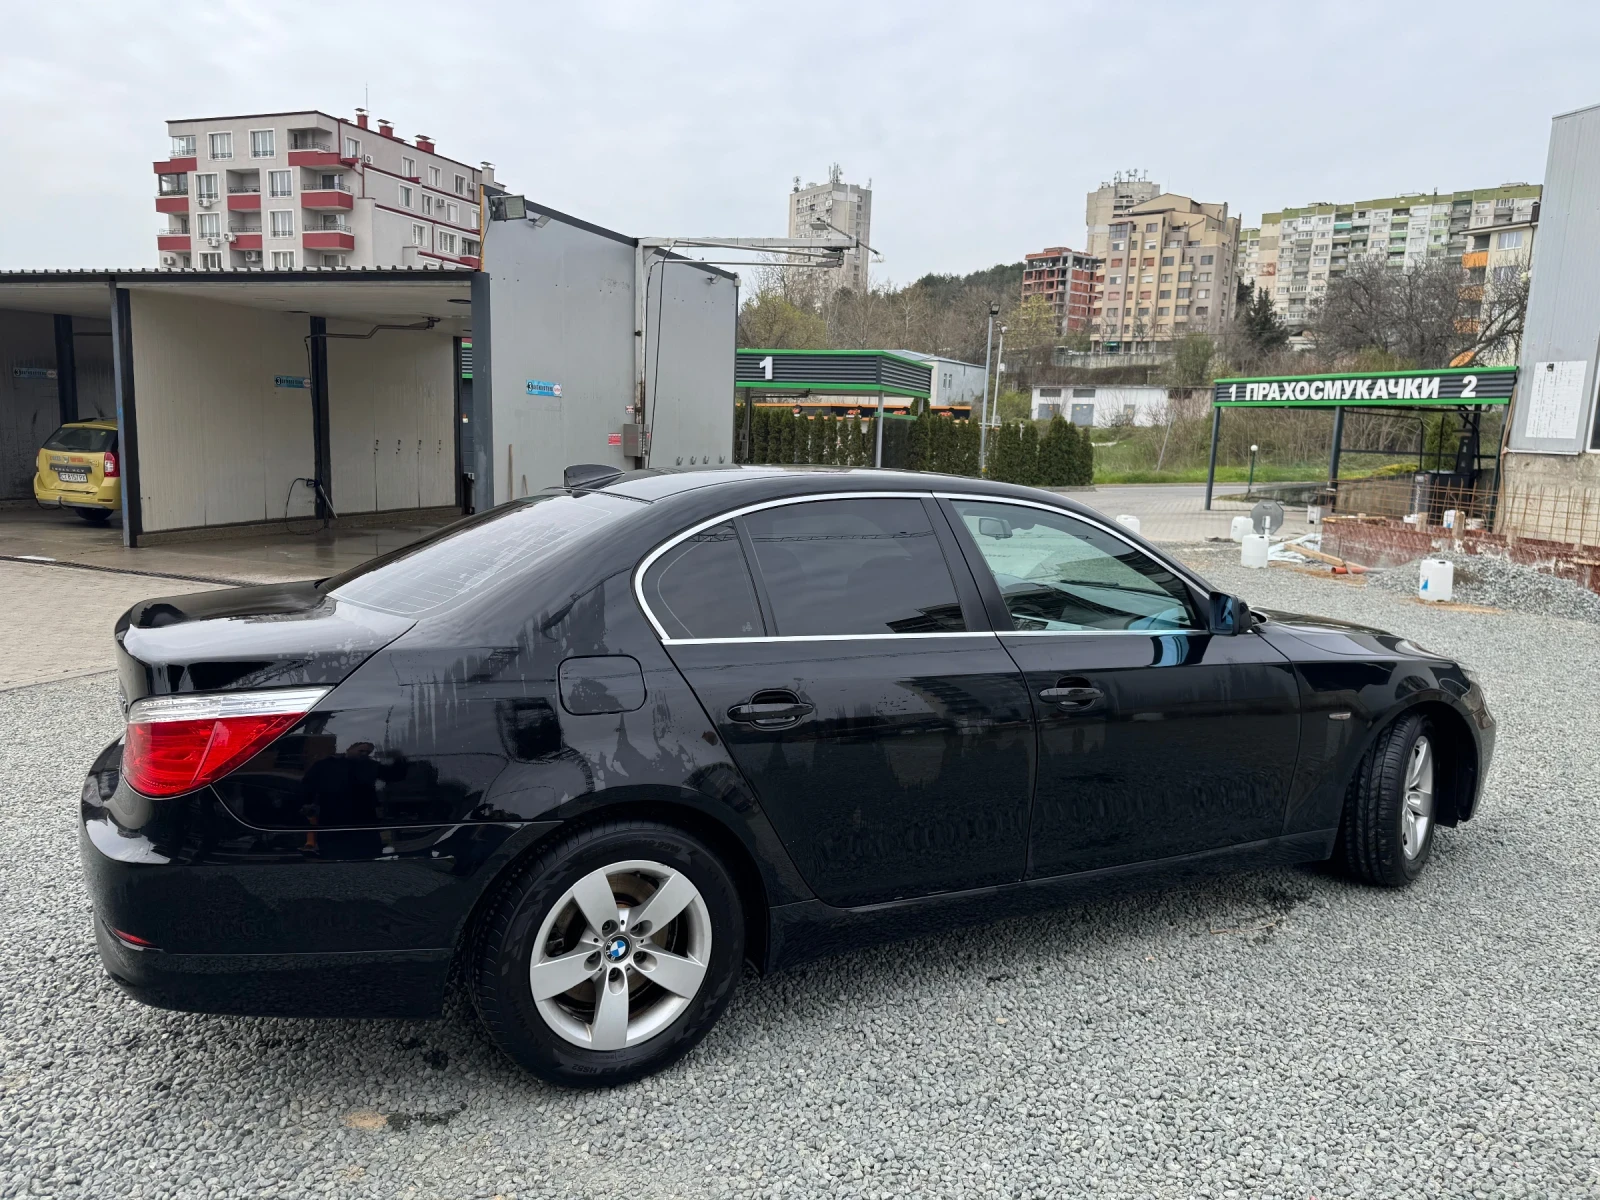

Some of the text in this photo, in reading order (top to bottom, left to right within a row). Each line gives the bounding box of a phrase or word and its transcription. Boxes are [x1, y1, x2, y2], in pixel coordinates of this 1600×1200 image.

[759, 356, 773, 380] 1
[1228, 375, 1478, 402] 1 ПРАХОСМУКАЧКИ 2
[571, 1063, 597, 1074] HS52
